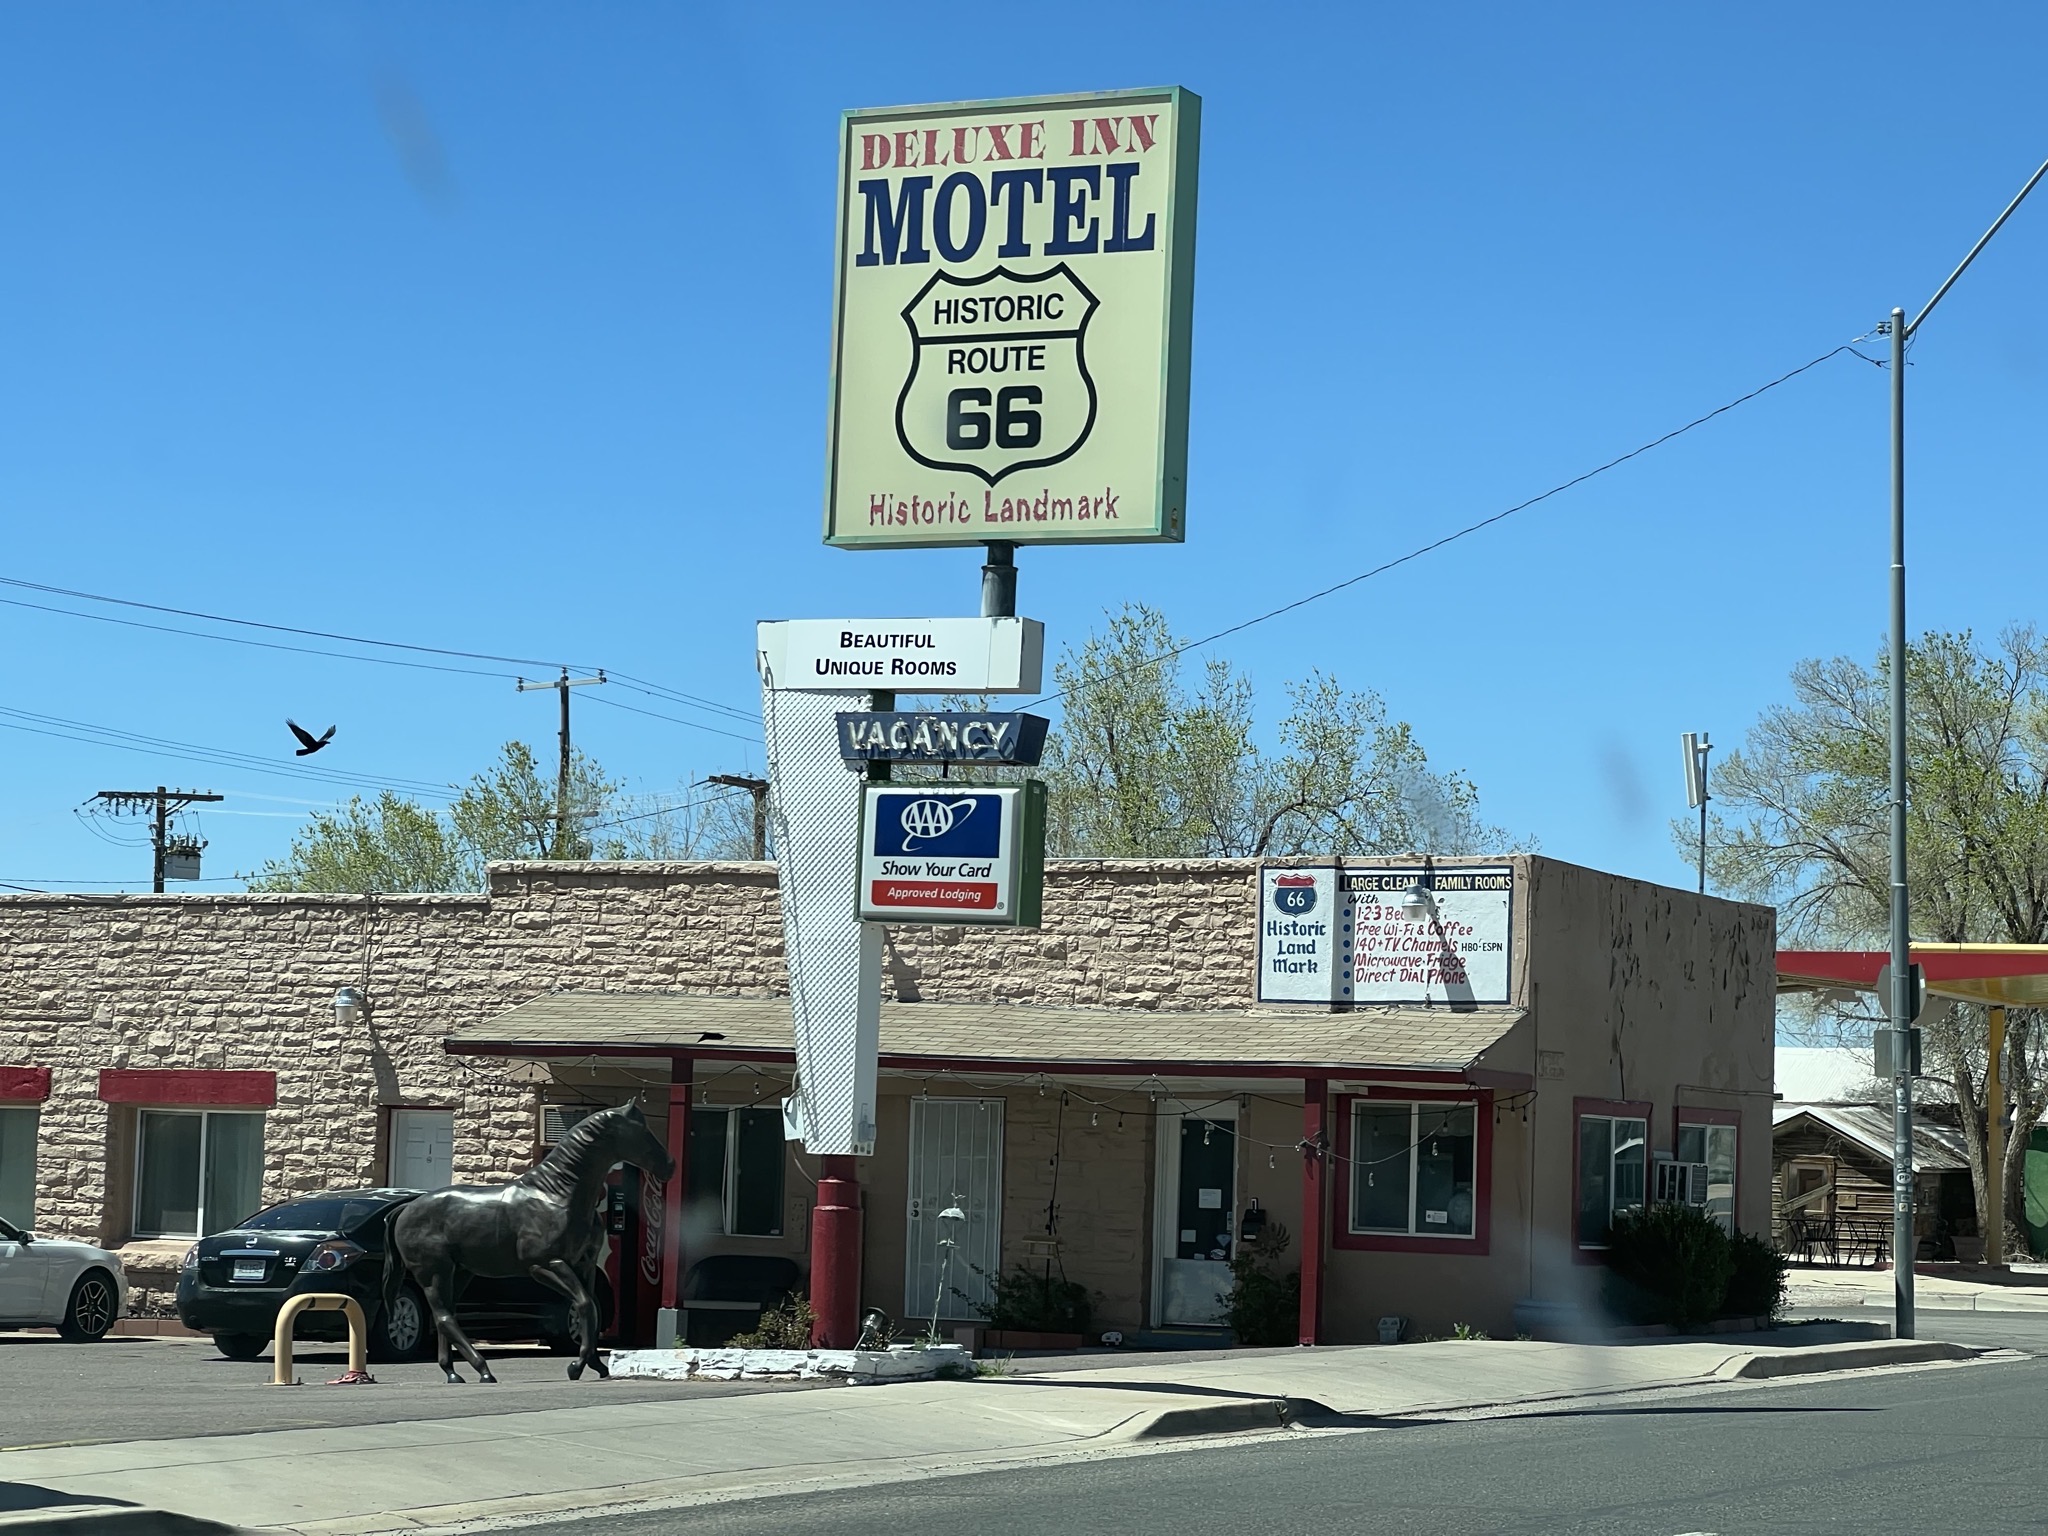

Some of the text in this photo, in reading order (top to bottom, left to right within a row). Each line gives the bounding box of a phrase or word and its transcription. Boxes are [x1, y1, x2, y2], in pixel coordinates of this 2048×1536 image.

[860, 114, 1160, 170] DELUXE INN
[856, 162, 1156, 267] MOTEL
[934, 293, 1064, 324] HISTORIC
[947, 345, 1046, 374] ROUTE
[946, 385, 1043, 450] 66
[870, 487, 1120, 527] Historic Landmark
[840, 631, 936, 649] BEAUTIFUL
[815, 658, 957, 676] UNIQUE ROOMS
[847, 720, 1010, 751] VACANCY
[907, 801, 950, 835] AAA
[881, 861, 991, 878] Show Your Card
[1344, 875, 1512, 891] LARGE CLEAN FAMILY ROOMS
[887, 886, 982, 903] Approved Lodging
[1287, 891, 1305, 907] 66
[1348, 893, 1379, 904] With
[1267, 921, 1327, 937] Historic
[1356, 921, 1473, 936] Free Wi-Fi & Coffee
[1277, 939, 1317, 955] Land
[1402, 937, 1458, 952] Channels
[1273, 958, 1318, 974] Mark
[1356, 968, 1396, 983] Direct
